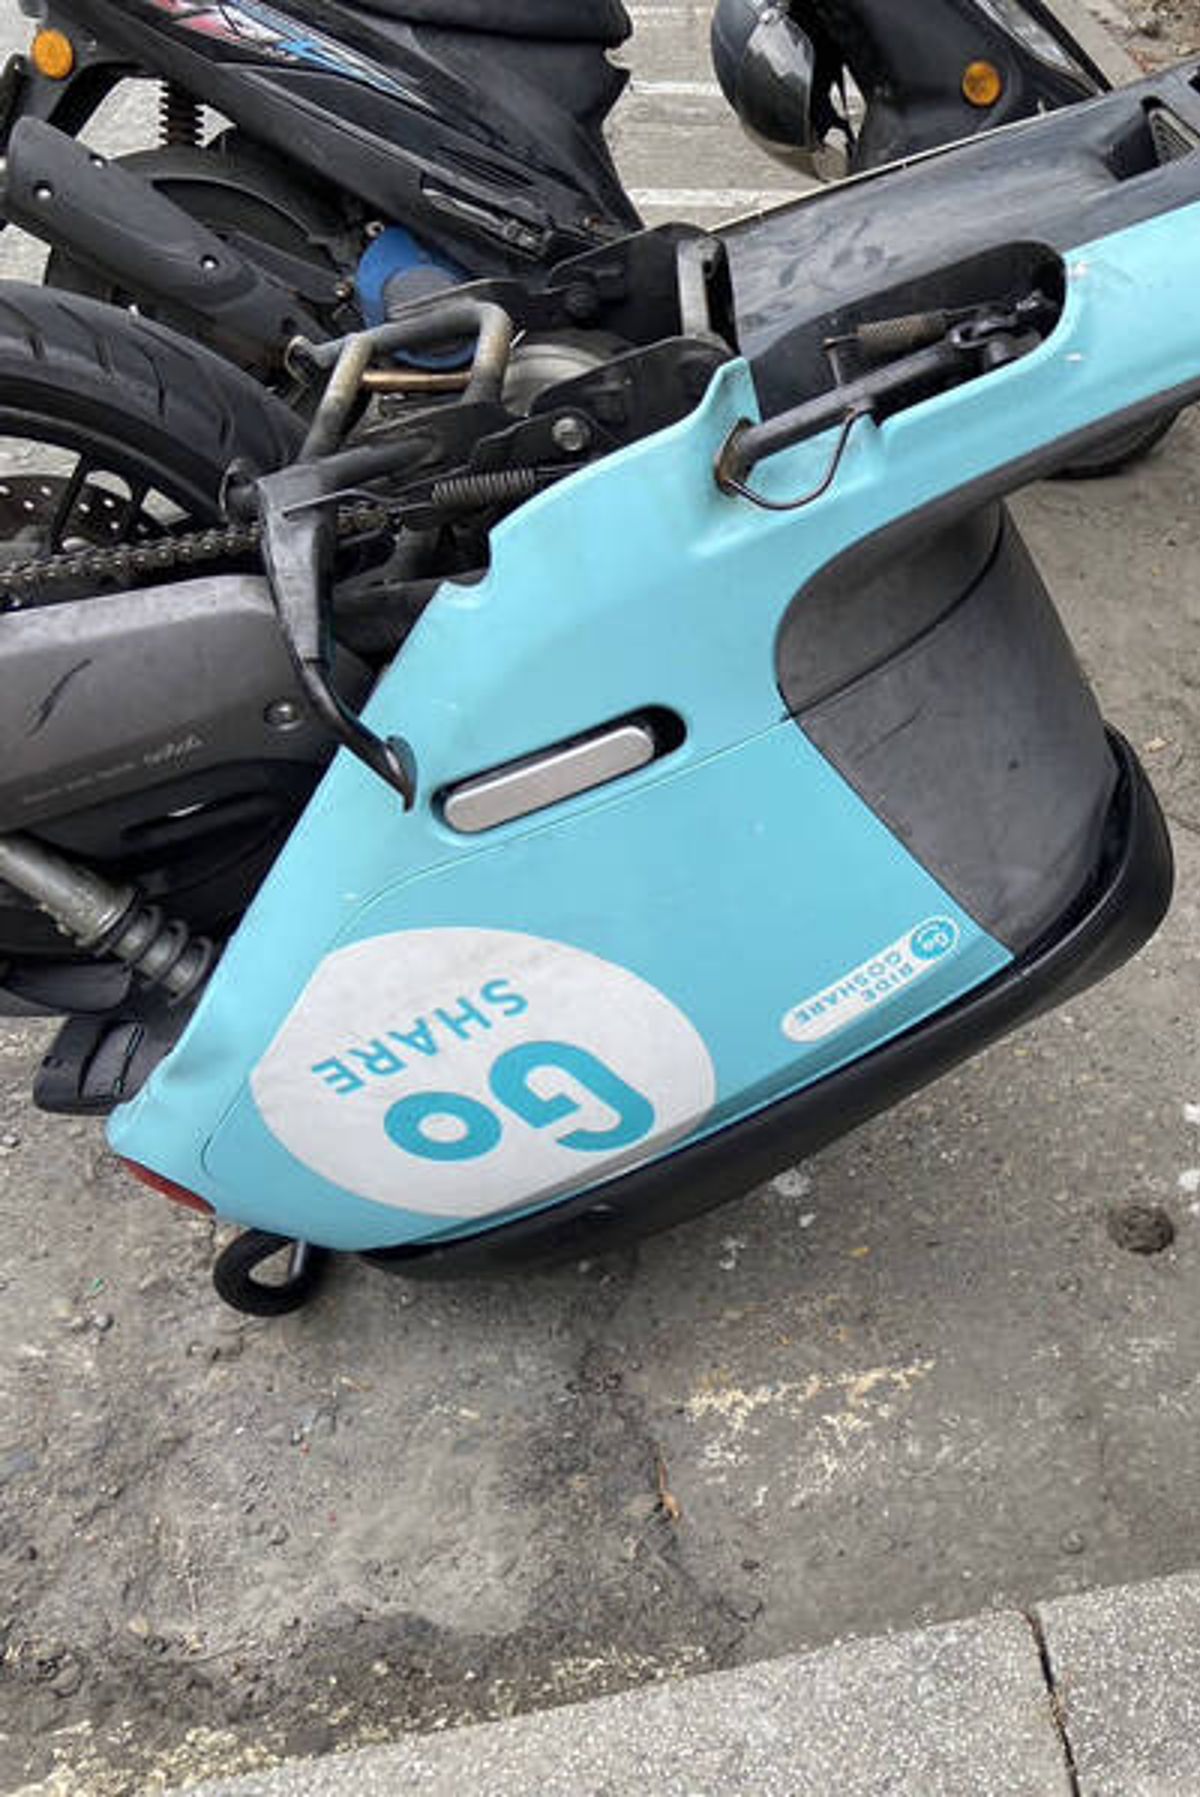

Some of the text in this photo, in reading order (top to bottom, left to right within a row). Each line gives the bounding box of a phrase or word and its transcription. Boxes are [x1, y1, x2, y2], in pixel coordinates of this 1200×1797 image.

[795, 951, 902, 1023] GOSHARE
[861, 962, 914, 1003] RIDE
[311, 978, 528, 1094] SHARE
